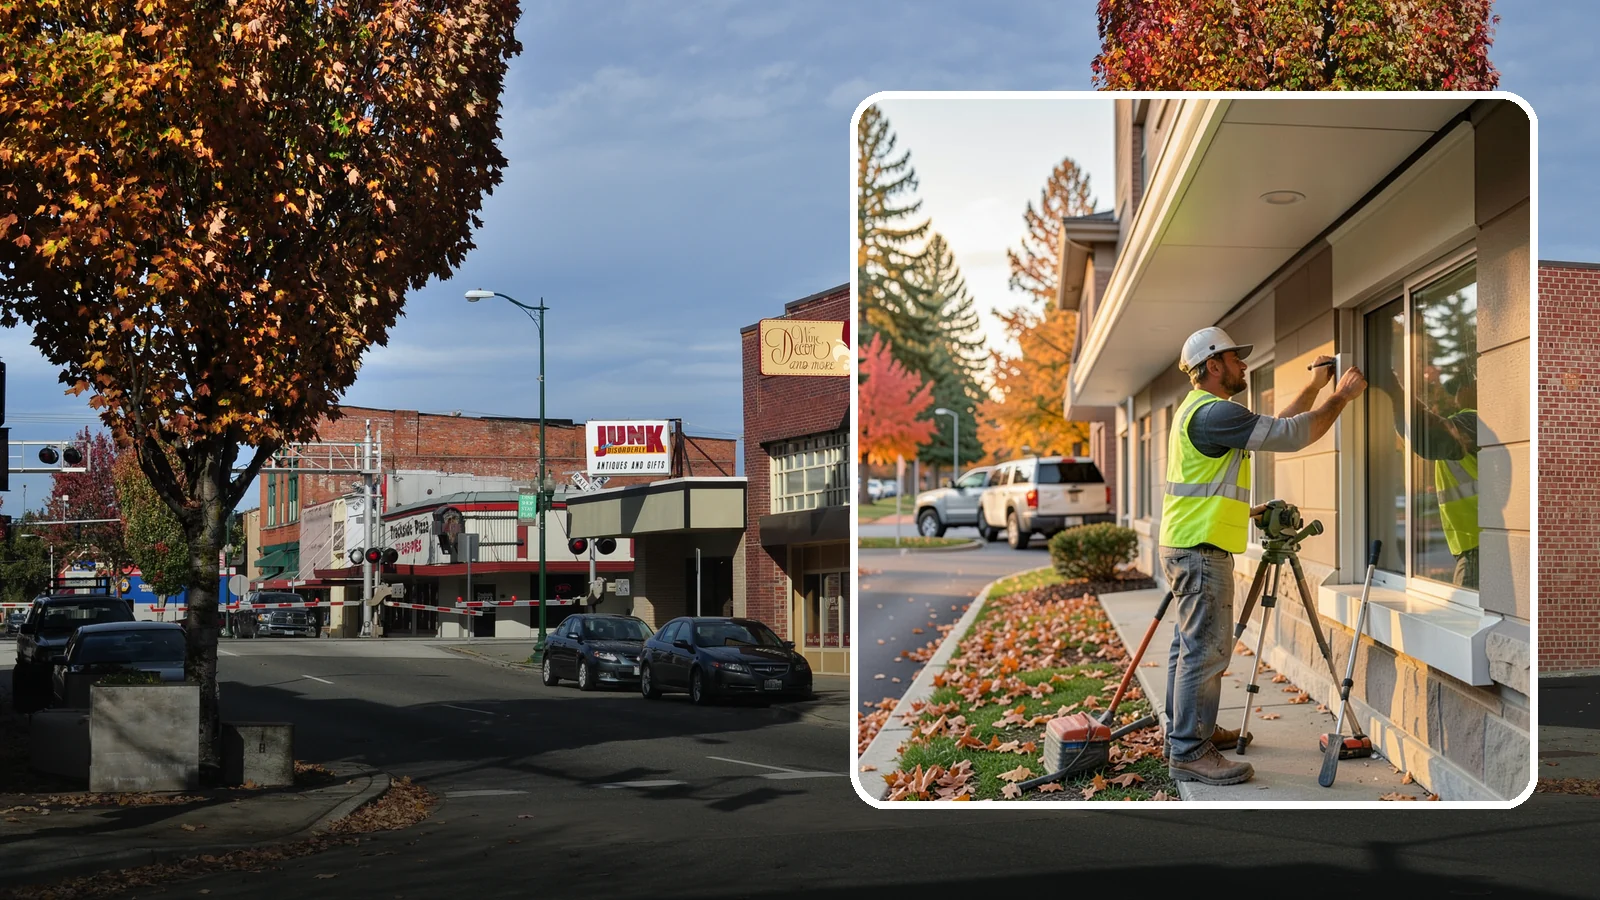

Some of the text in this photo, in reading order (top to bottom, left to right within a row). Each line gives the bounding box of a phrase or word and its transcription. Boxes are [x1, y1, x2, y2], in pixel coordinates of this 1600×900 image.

[595, 425, 665, 457] JUNK
[607, 446, 646, 454] DISORDERLY
[596, 460, 665, 470] ANTIQUES AND GIFTS
[414, 519, 429, 534] Pizza
